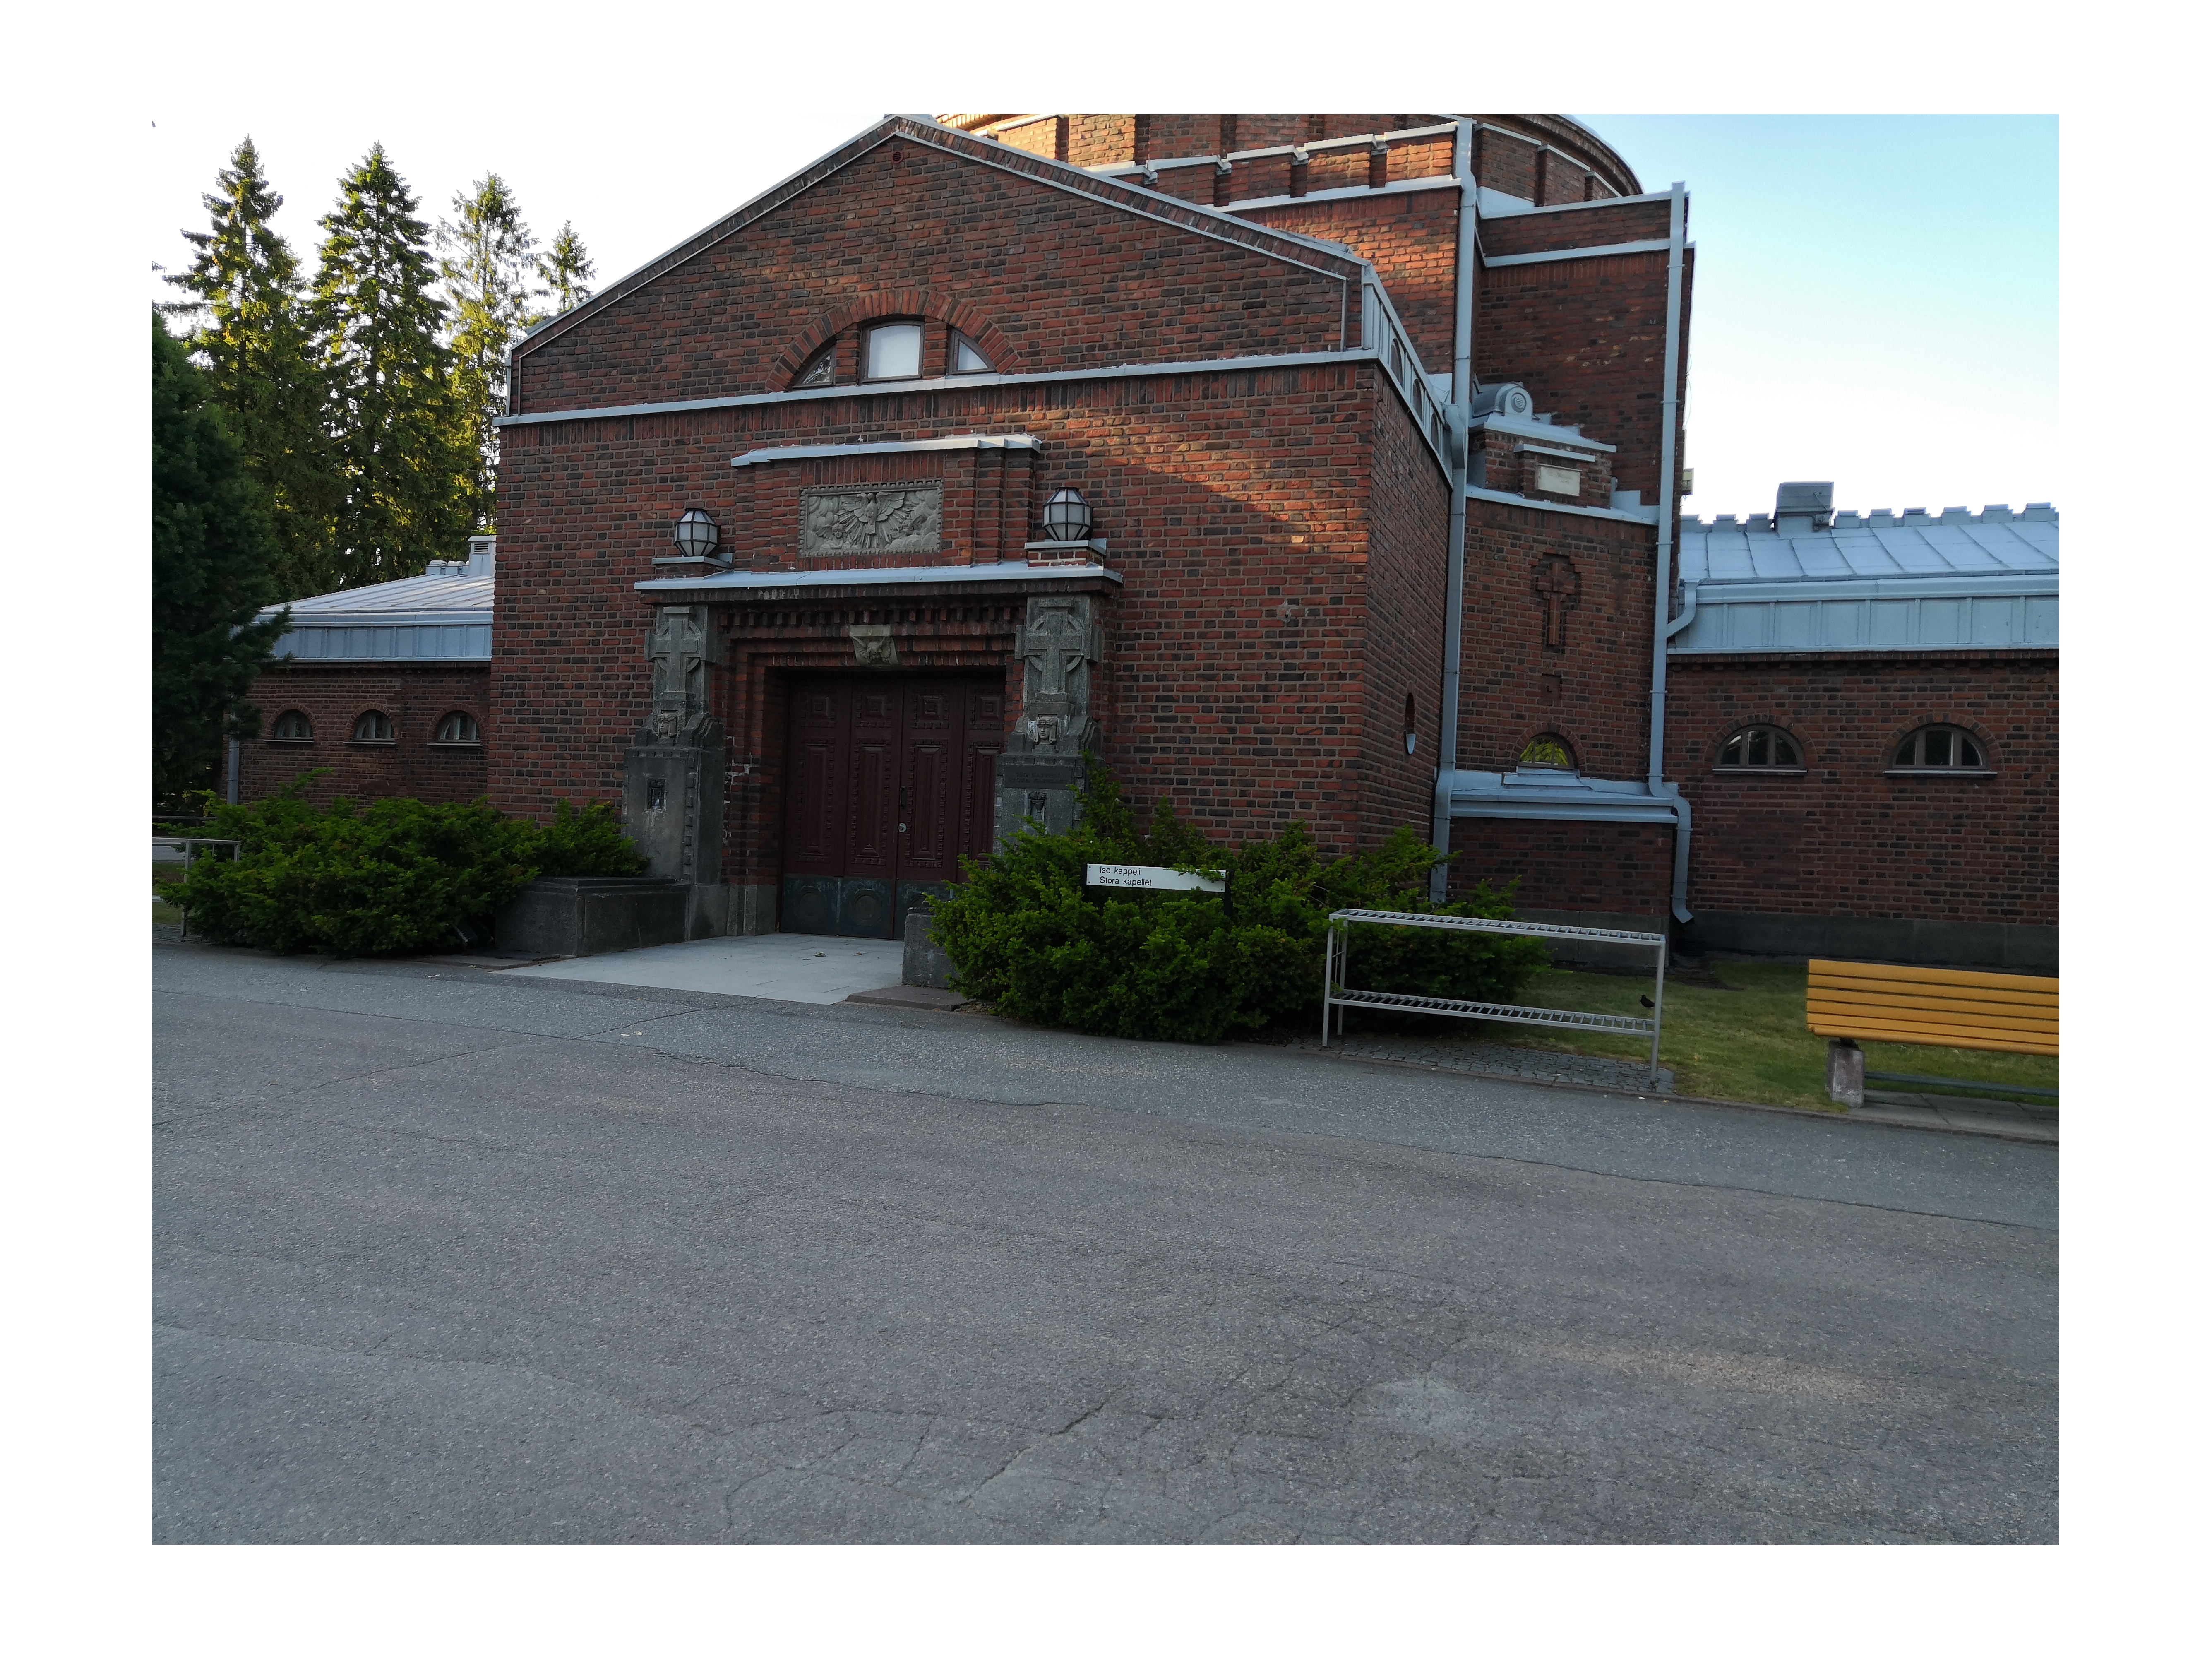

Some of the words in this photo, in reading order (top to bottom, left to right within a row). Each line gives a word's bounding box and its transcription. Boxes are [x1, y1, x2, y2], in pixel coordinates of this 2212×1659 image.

[1114, 867, 1141, 876] kappeli
[1100, 876, 1119, 884] Stora
[1123, 878, 1152, 887] kapellet
